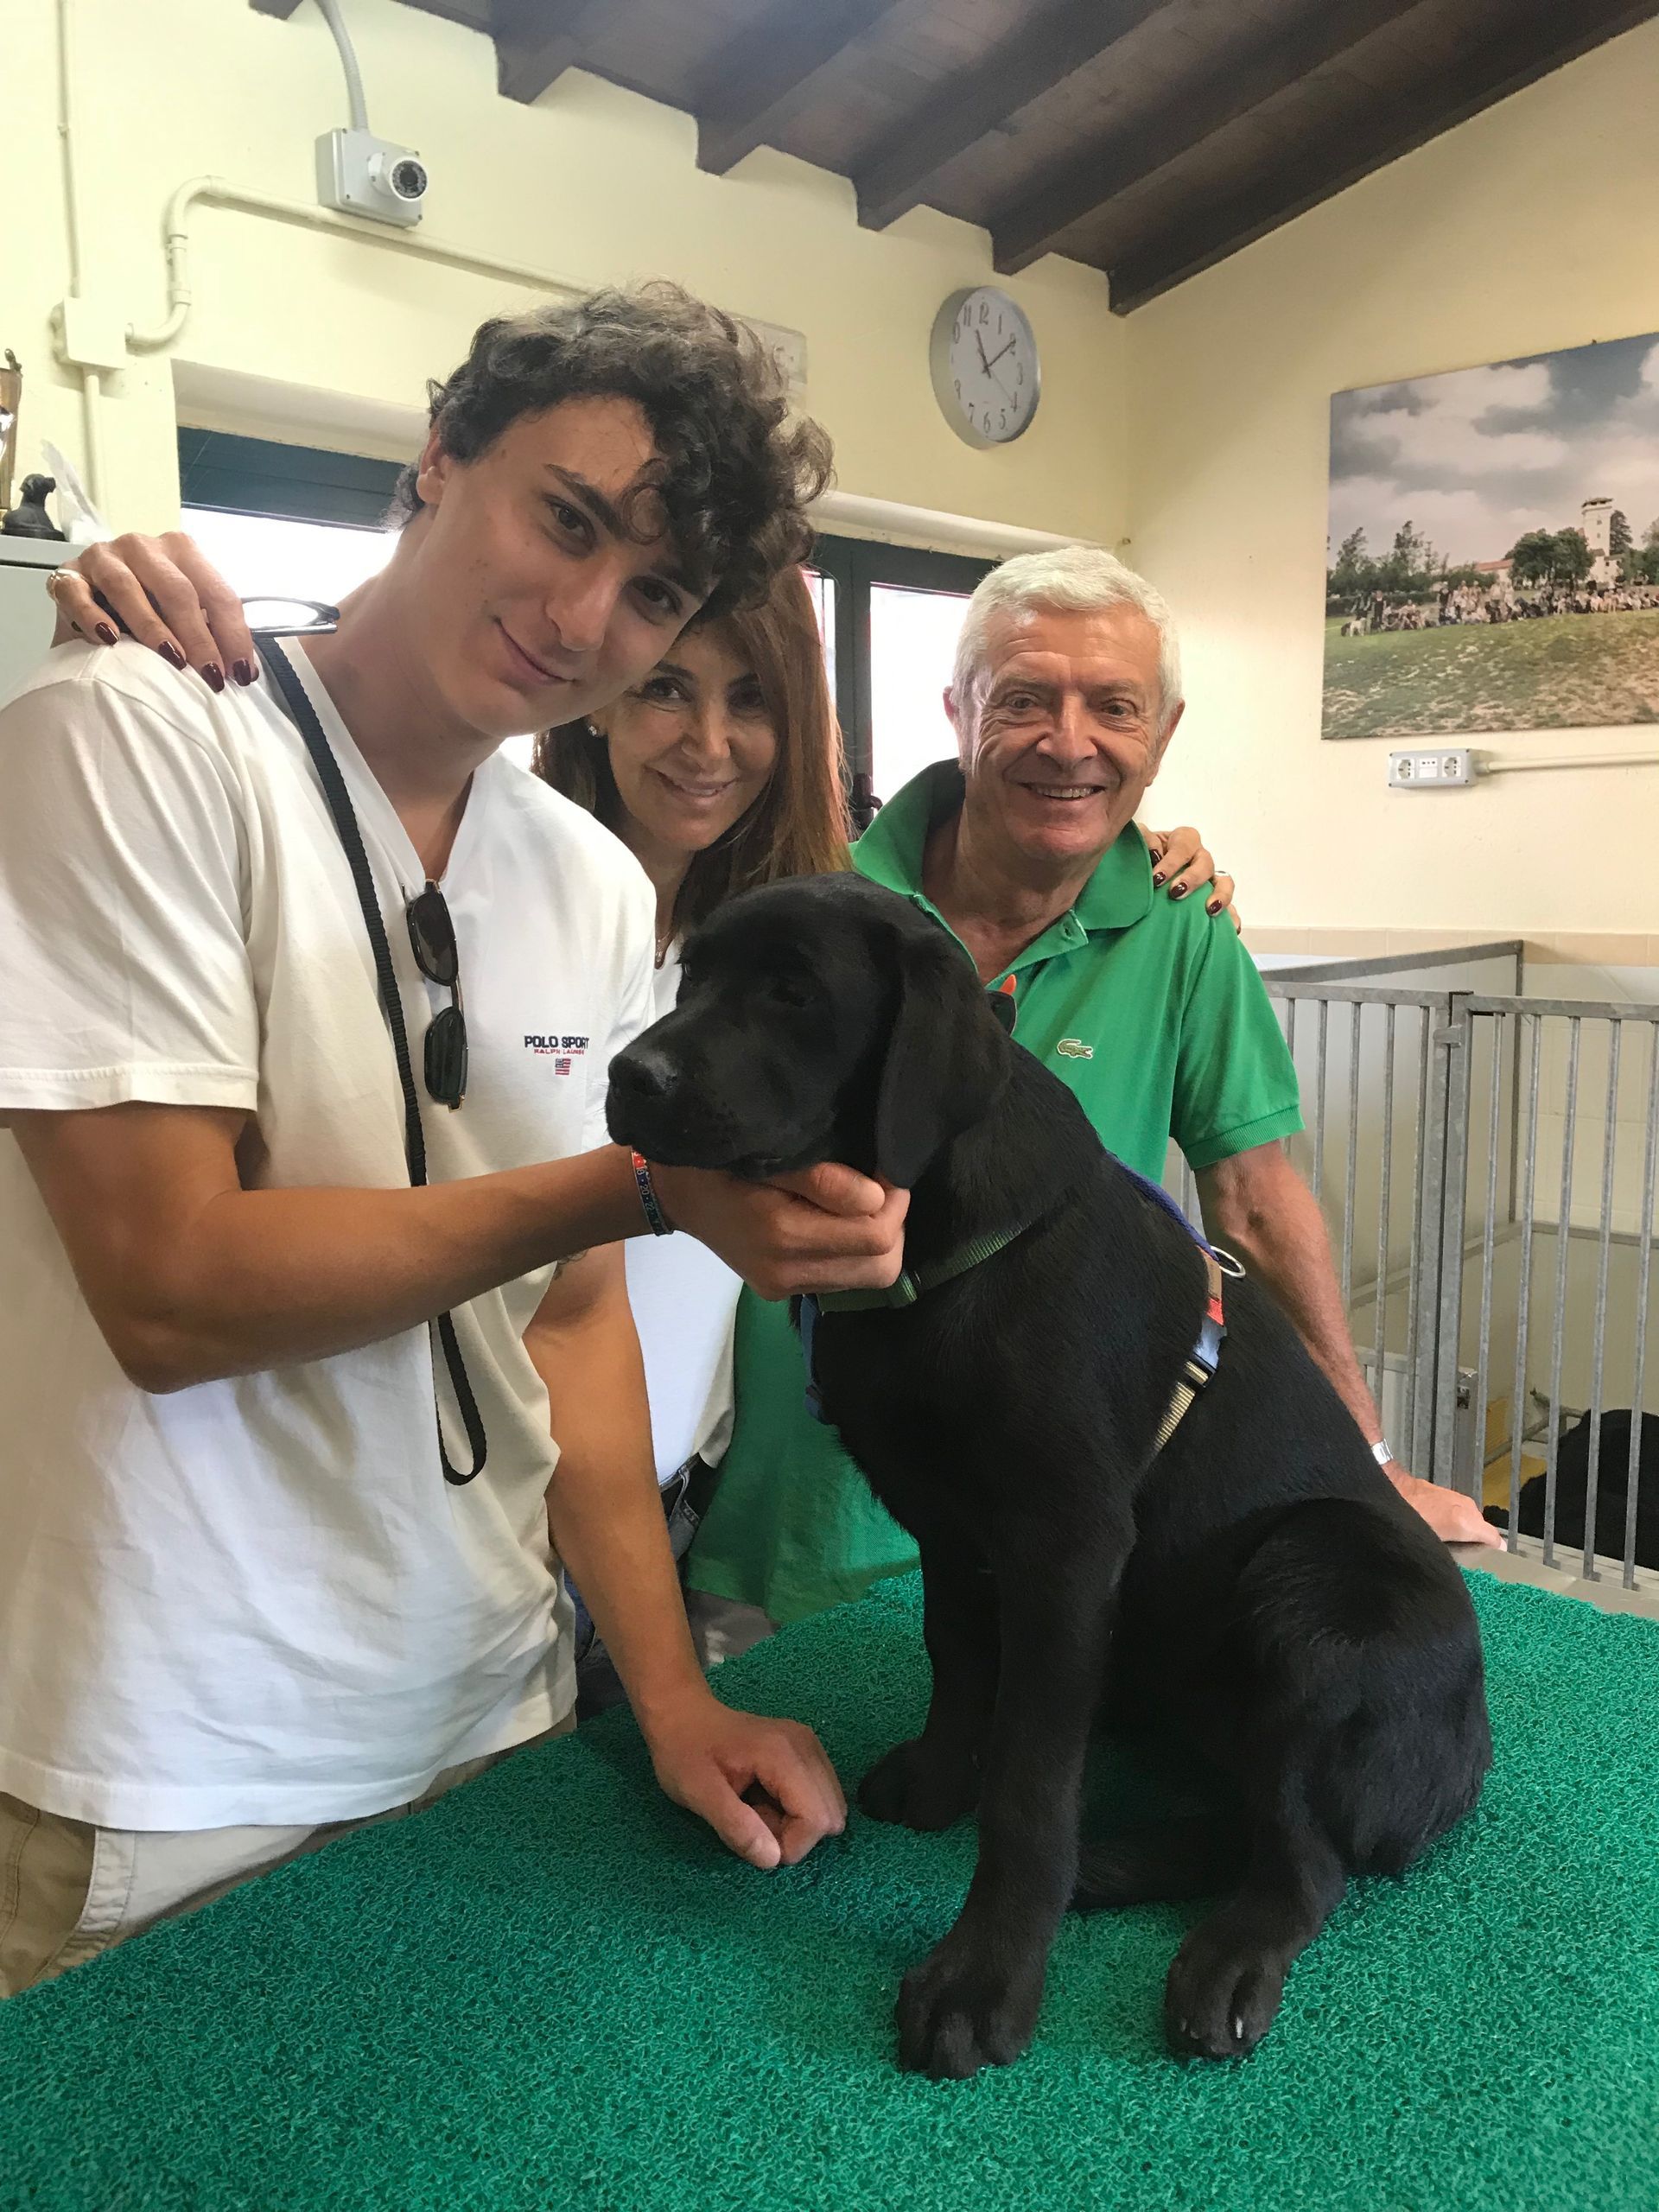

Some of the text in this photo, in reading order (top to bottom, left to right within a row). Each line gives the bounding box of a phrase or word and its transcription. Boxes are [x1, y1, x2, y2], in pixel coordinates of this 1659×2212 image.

[963, 304, 971, 327] 11
[979, 302, 988, 325] 12
[998, 314, 1002, 335] 1
[969, 403, 975, 423] 7
[983, 411, 991, 434] 6
[524, 1035, 589, 1049] POLO SPORT
[640, 1184, 650, 1195] 20
